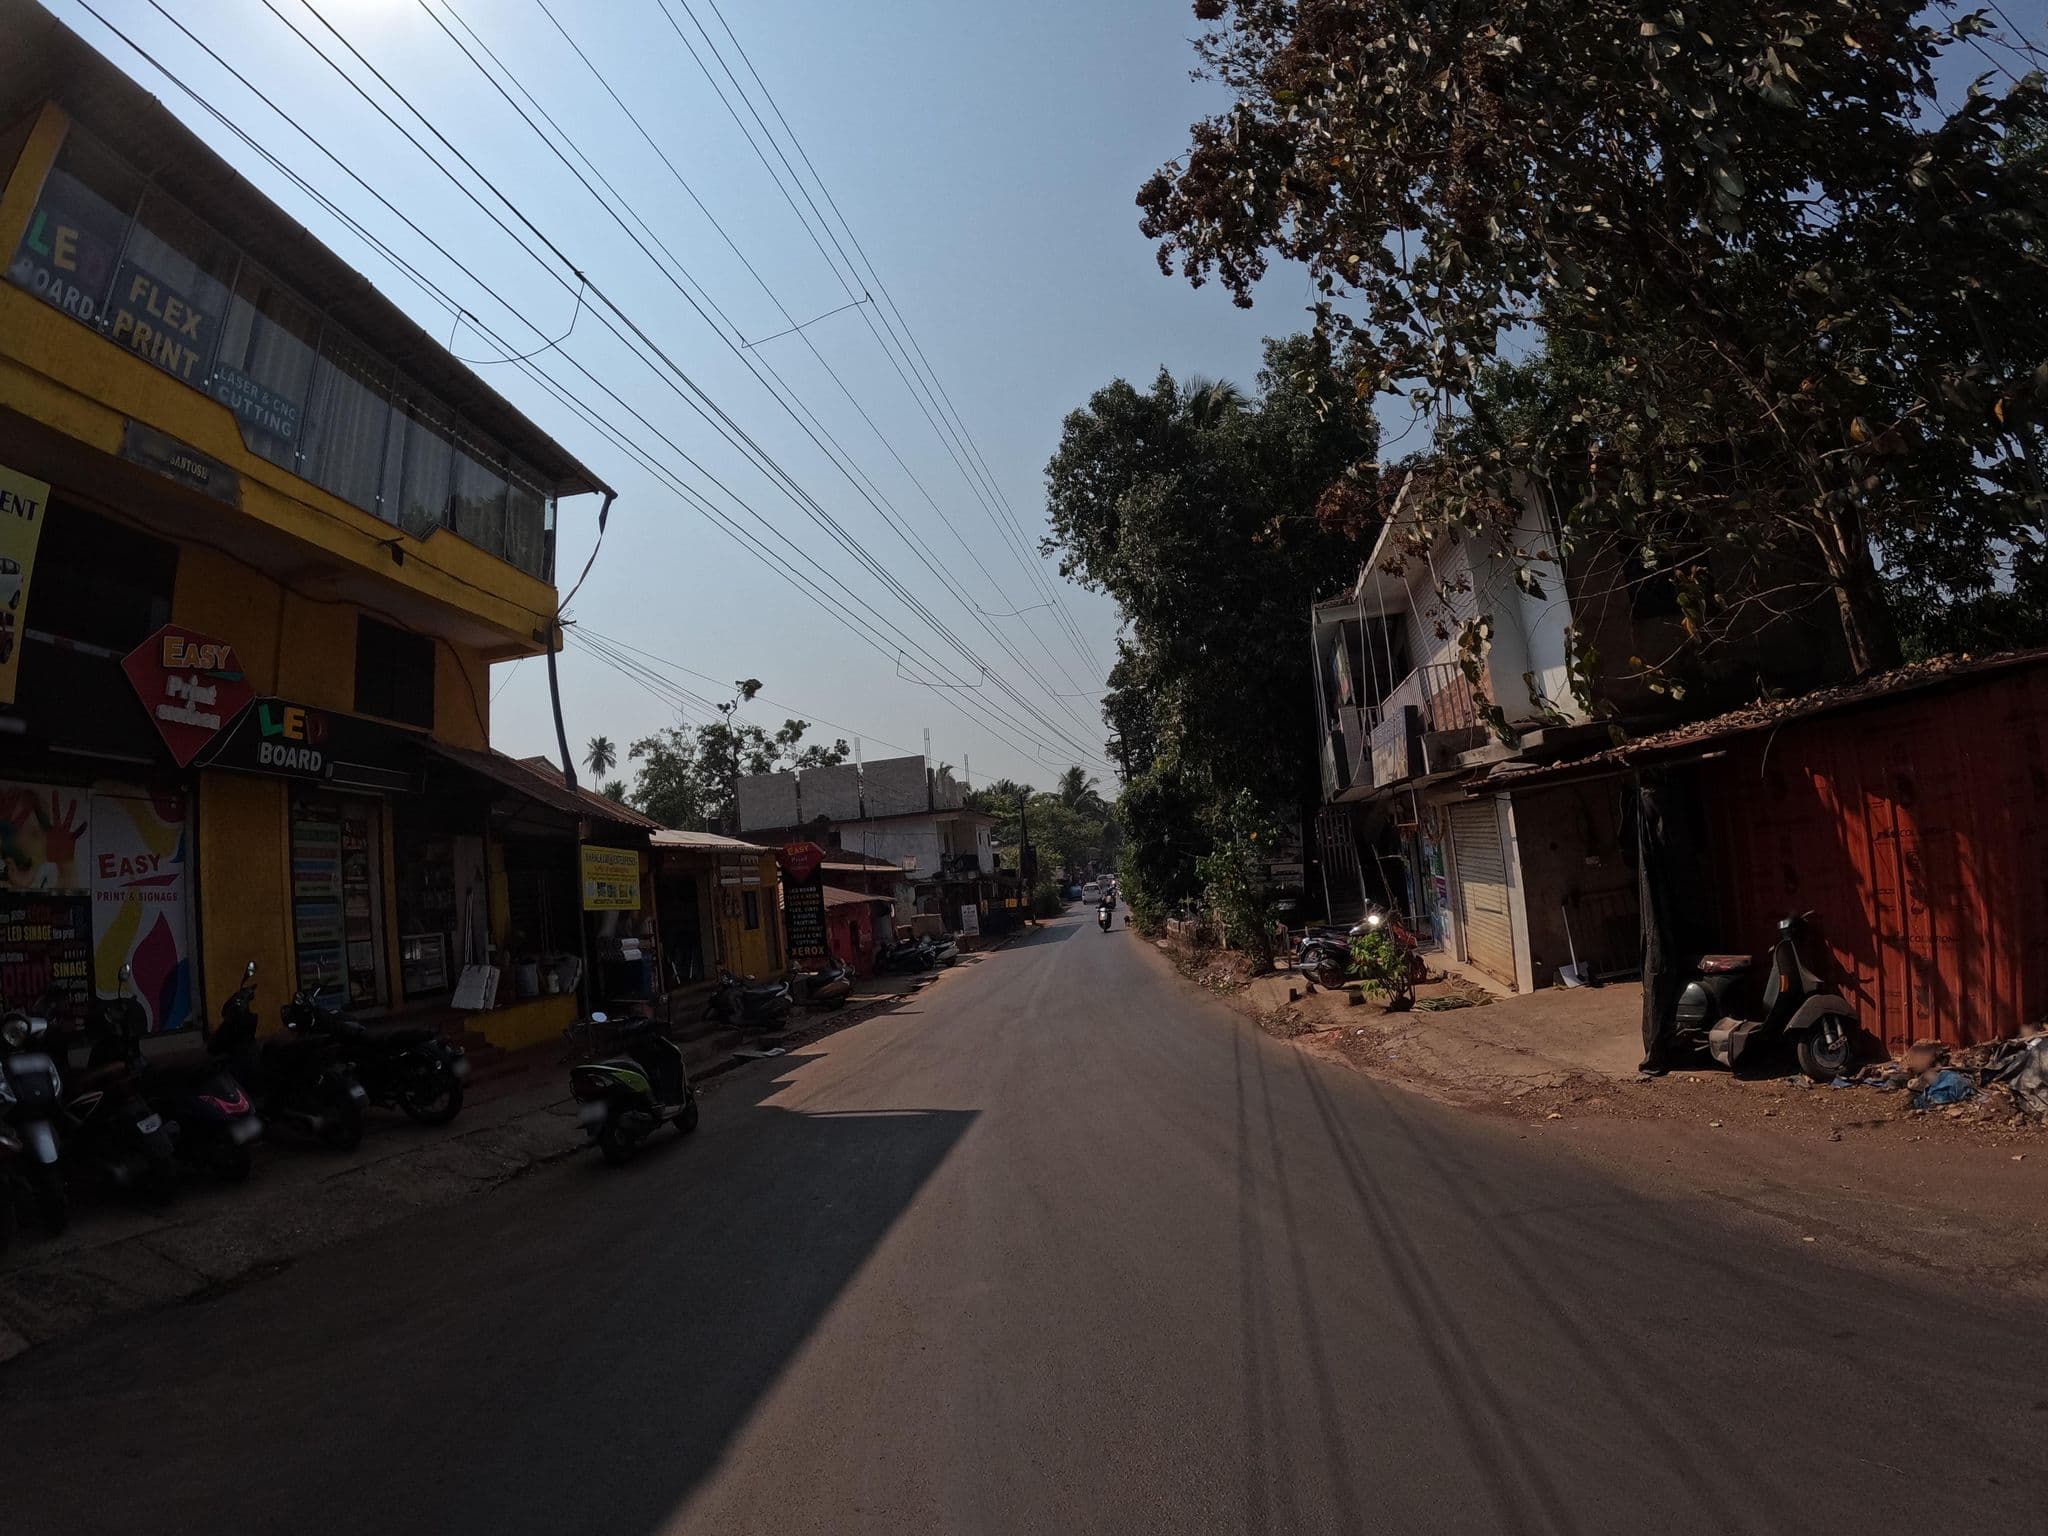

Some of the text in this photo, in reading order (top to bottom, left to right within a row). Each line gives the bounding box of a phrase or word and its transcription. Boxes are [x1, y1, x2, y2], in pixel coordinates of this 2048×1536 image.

[129, 273, 203, 341] FLEX
[112, 308, 200, 379] PRINT
[218, 367, 259, 400] LASER
[273, 399, 297, 421] CNC
[218, 386, 292, 437] CUTTING
[259, 741, 323, 772] BOARD
[96, 891, 126, 902] PRINT
[138, 891, 178, 902] SIGNAGE
[53, 960, 88, 977] SINAGE
[791, 945, 825, 956] XEROX
